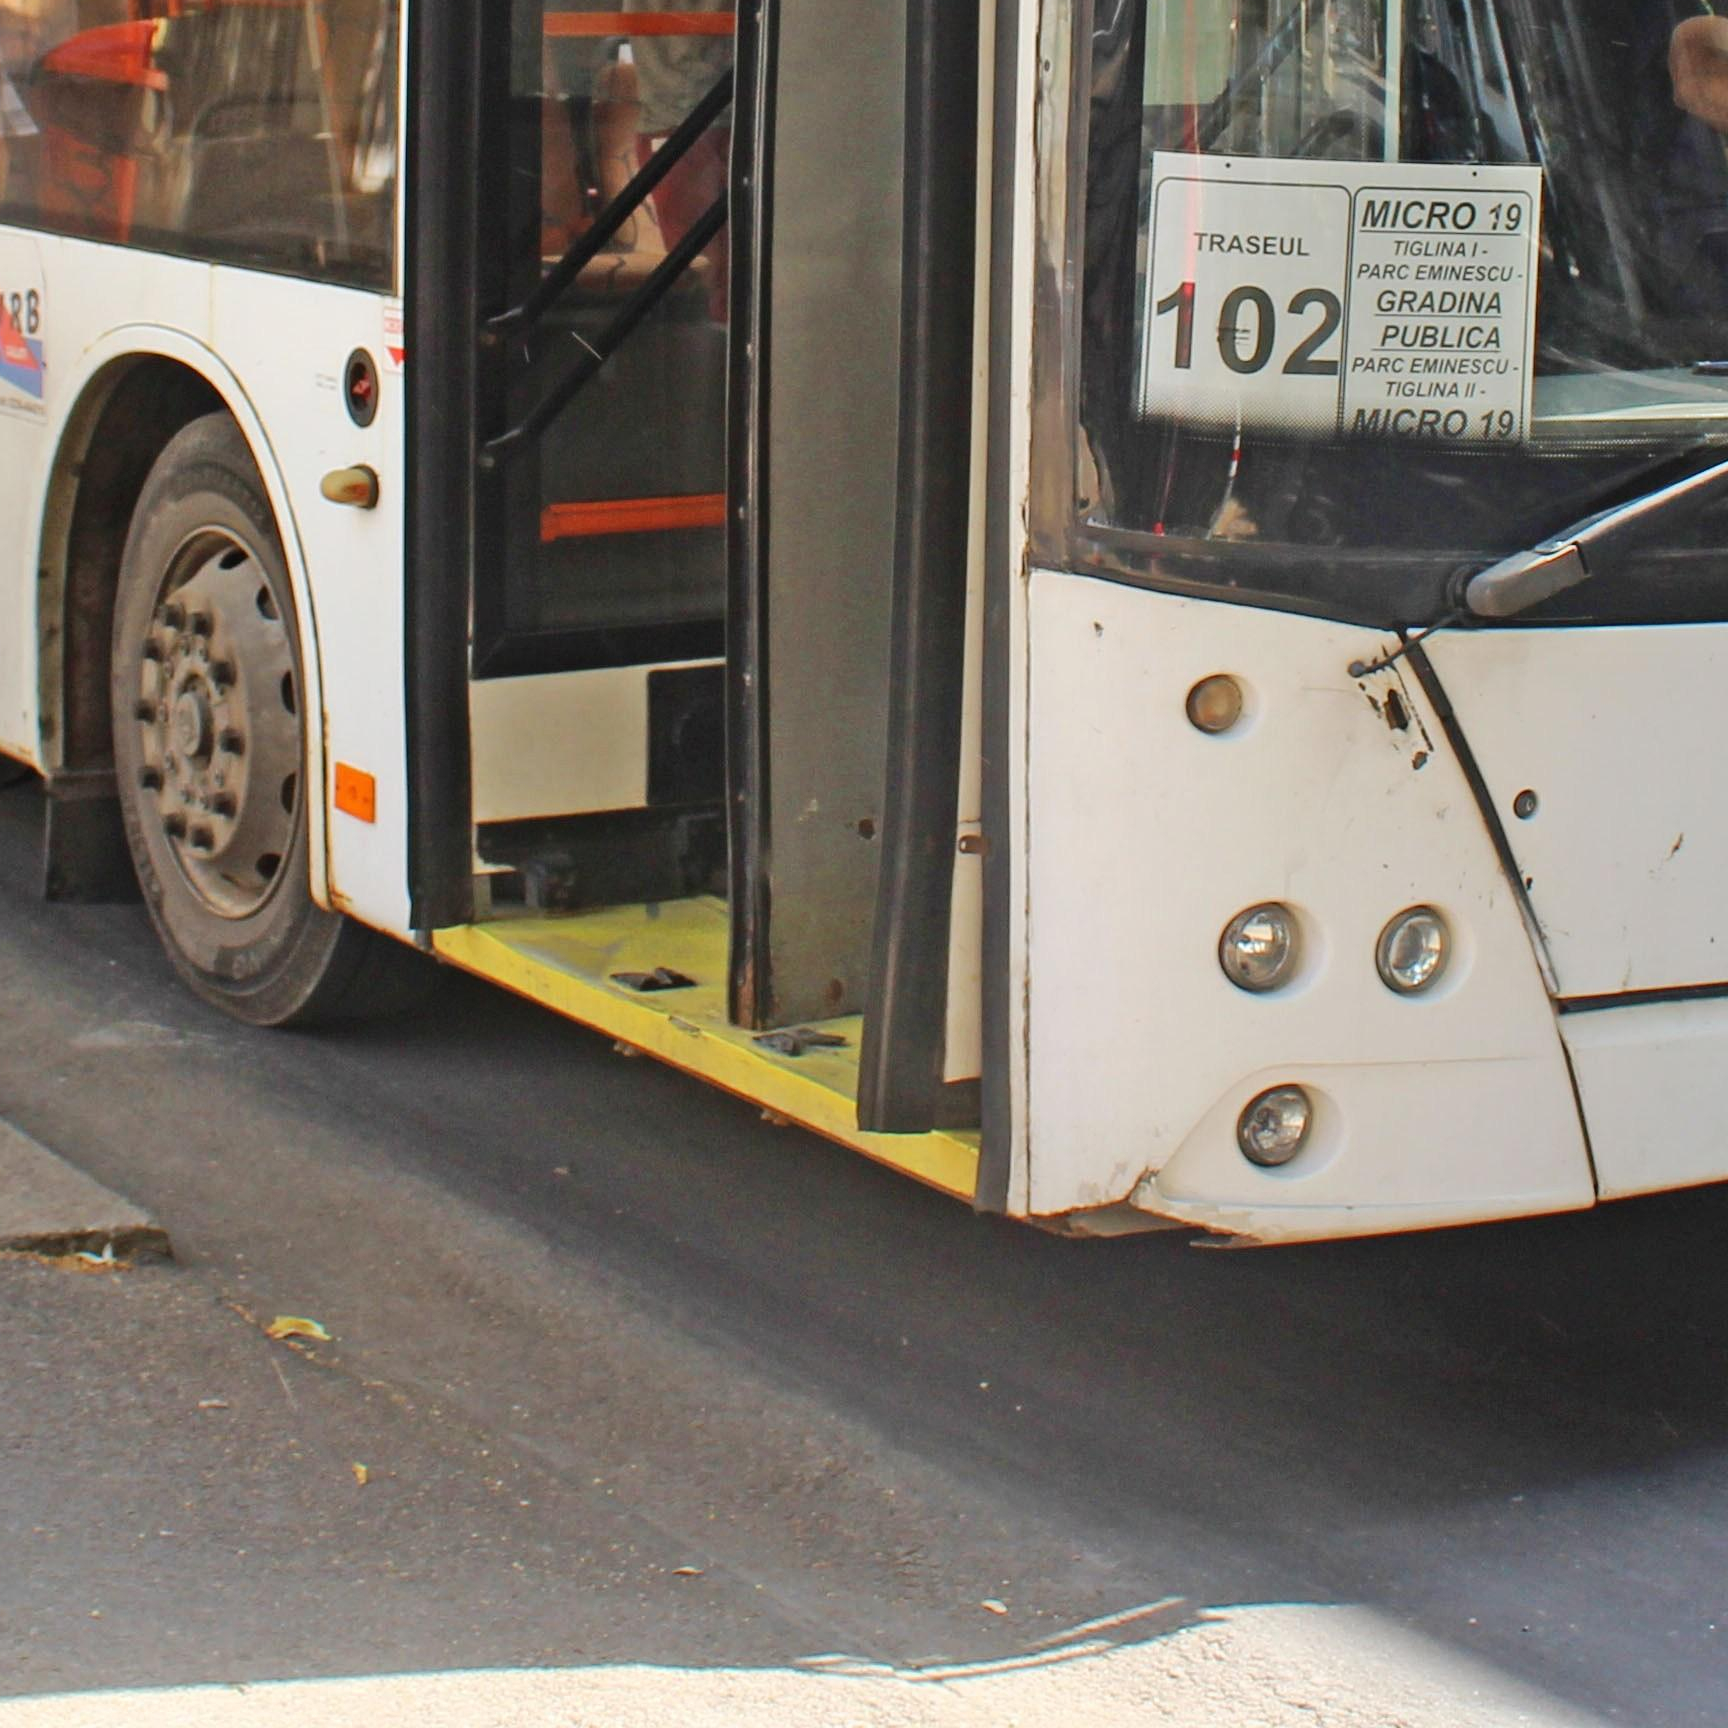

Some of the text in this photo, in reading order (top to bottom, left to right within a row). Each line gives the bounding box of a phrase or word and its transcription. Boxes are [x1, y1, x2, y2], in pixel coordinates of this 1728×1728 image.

[1361, 200, 1522, 231] MICRO 19
[1193, 232, 1310, 257] TRASEUL
[1393, 240, 1467, 257] TIGLINA
[1356, 263, 1410, 280] PARC
[1414, 264, 1513, 282] EMINESCU
[1376, 290, 1502, 314] GRADINA
[1156, 281, 1343, 375] 102
[1380, 326, 1501, 349] PUBLICA
[1351, 357, 1406, 373] PARC
[1410, 358, 1509, 375] EMINESCU
[1385, 381, 1461, 398] TIGLINA
[1352, 408, 1513, 439] MICRO 19
